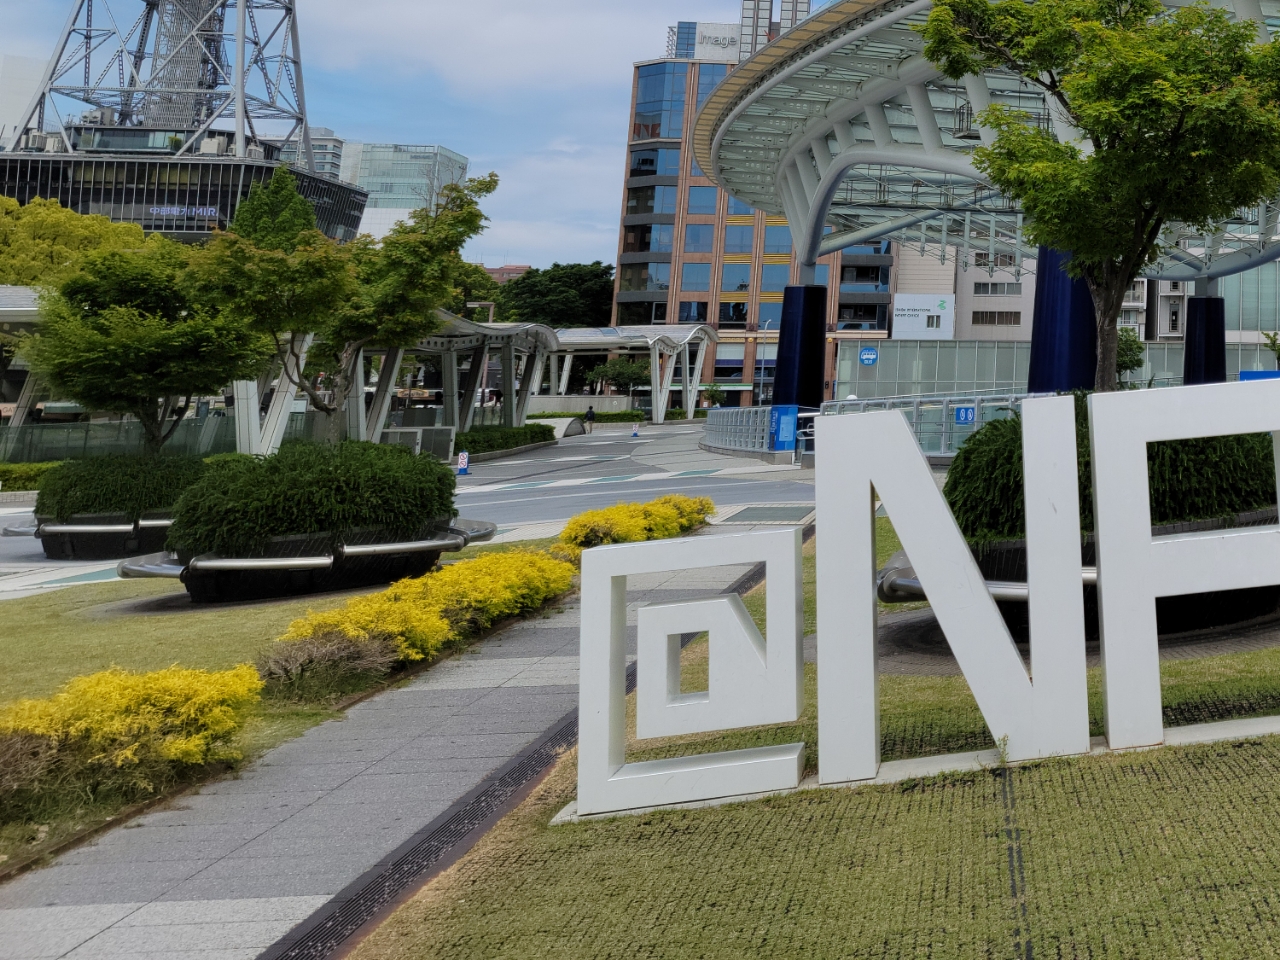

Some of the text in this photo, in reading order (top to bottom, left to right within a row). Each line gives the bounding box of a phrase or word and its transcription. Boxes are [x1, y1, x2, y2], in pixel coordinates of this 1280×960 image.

[698, 31, 737, 49] Image
[149, 206, 219, 217] 中部電力 MIR
